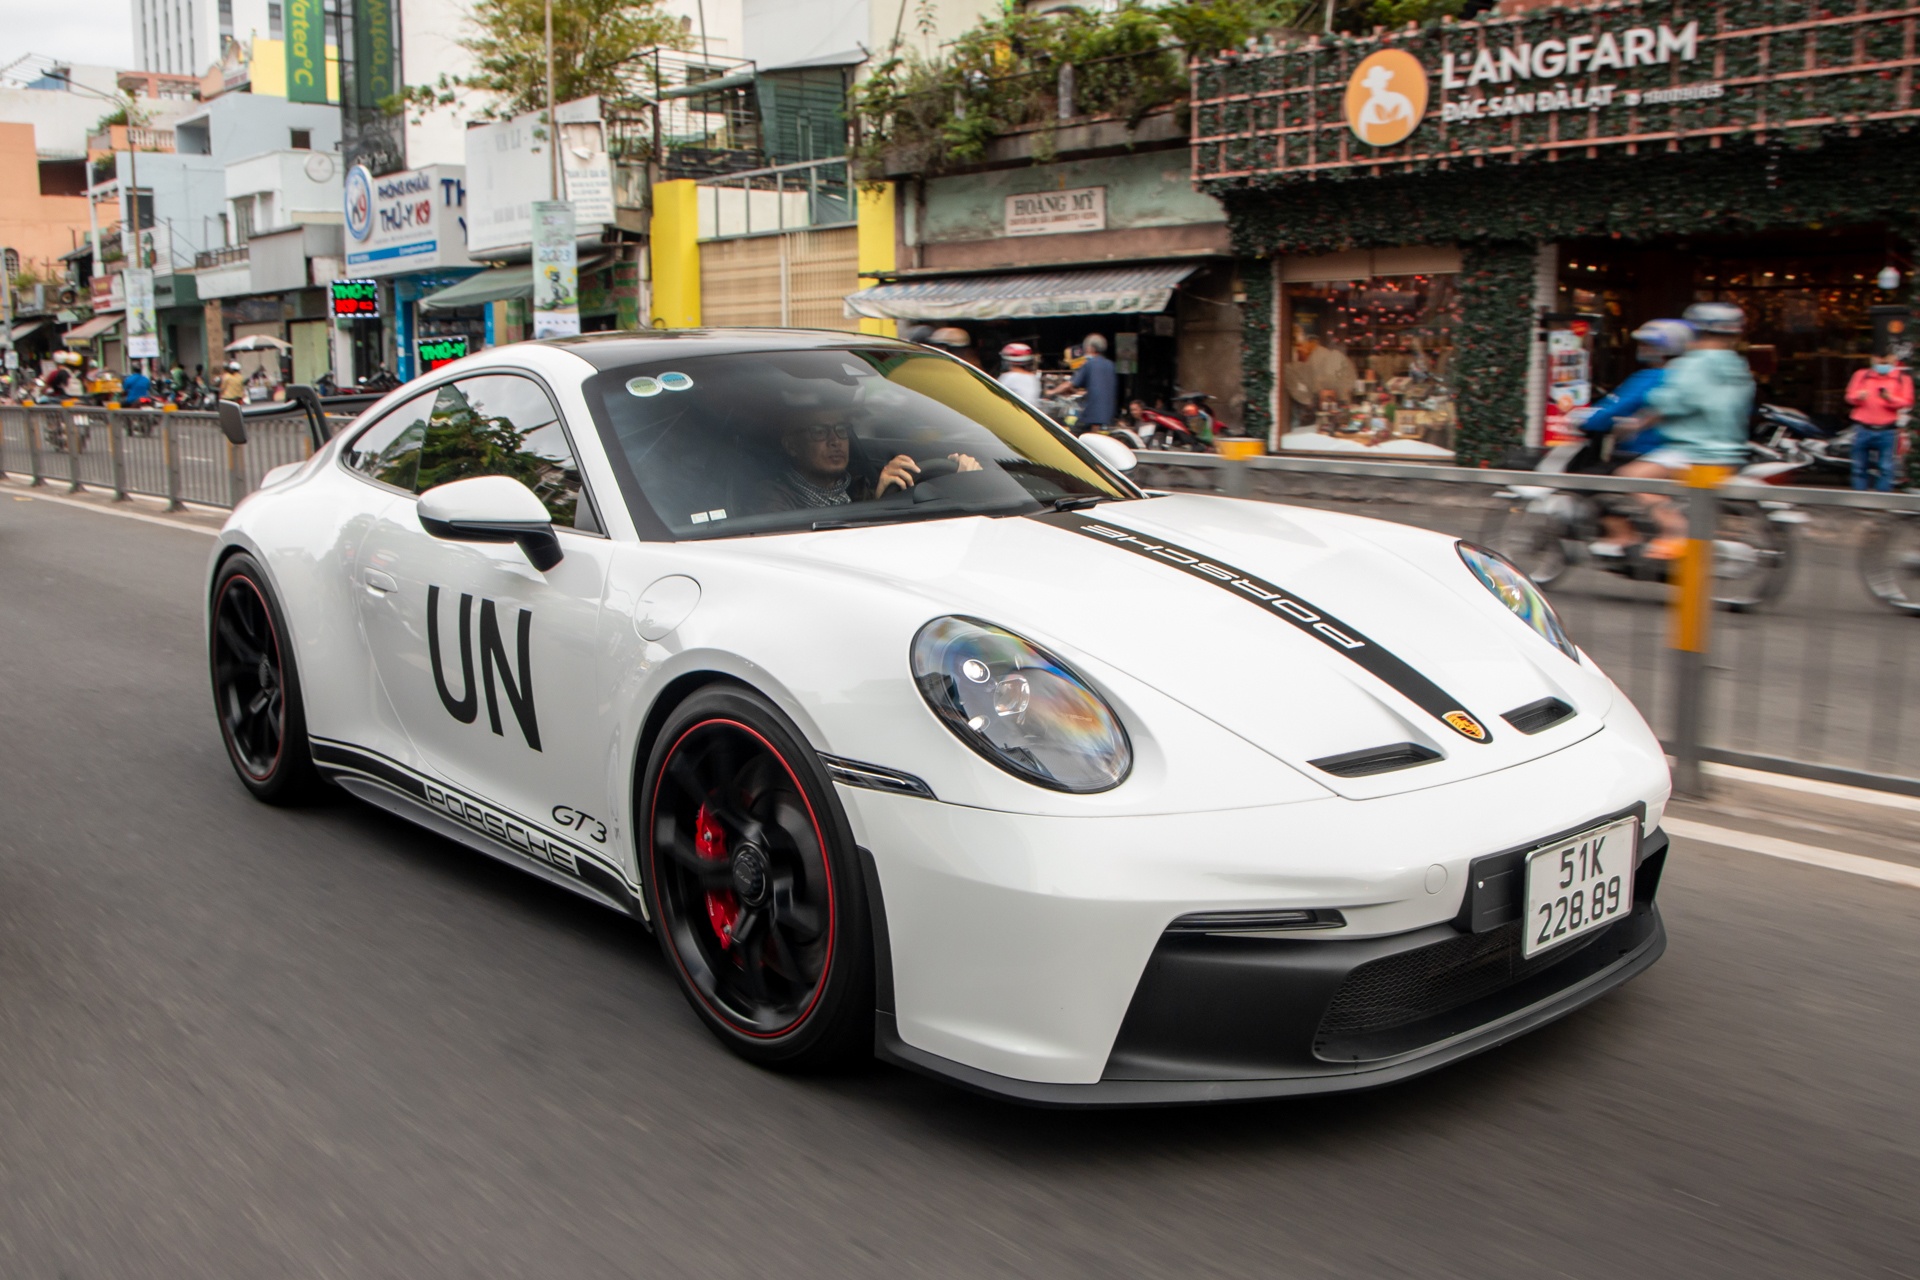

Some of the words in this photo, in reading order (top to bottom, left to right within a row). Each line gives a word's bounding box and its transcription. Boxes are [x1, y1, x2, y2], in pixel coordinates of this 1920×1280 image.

[1441, 21, 1698, 90] L'ANGFARM
[1572, 84, 1617, 112] LẠT
[415, 200, 431, 225] K9
[1080, 524, 1365, 649] PORSCHE
[427, 585, 543, 753] UN
[424, 783, 576, 874] PORSCHE
[551, 805, 608, 843] GT3
[1559, 836, 1606, 889] 51K
[1536, 875, 1621, 945] 228.89
